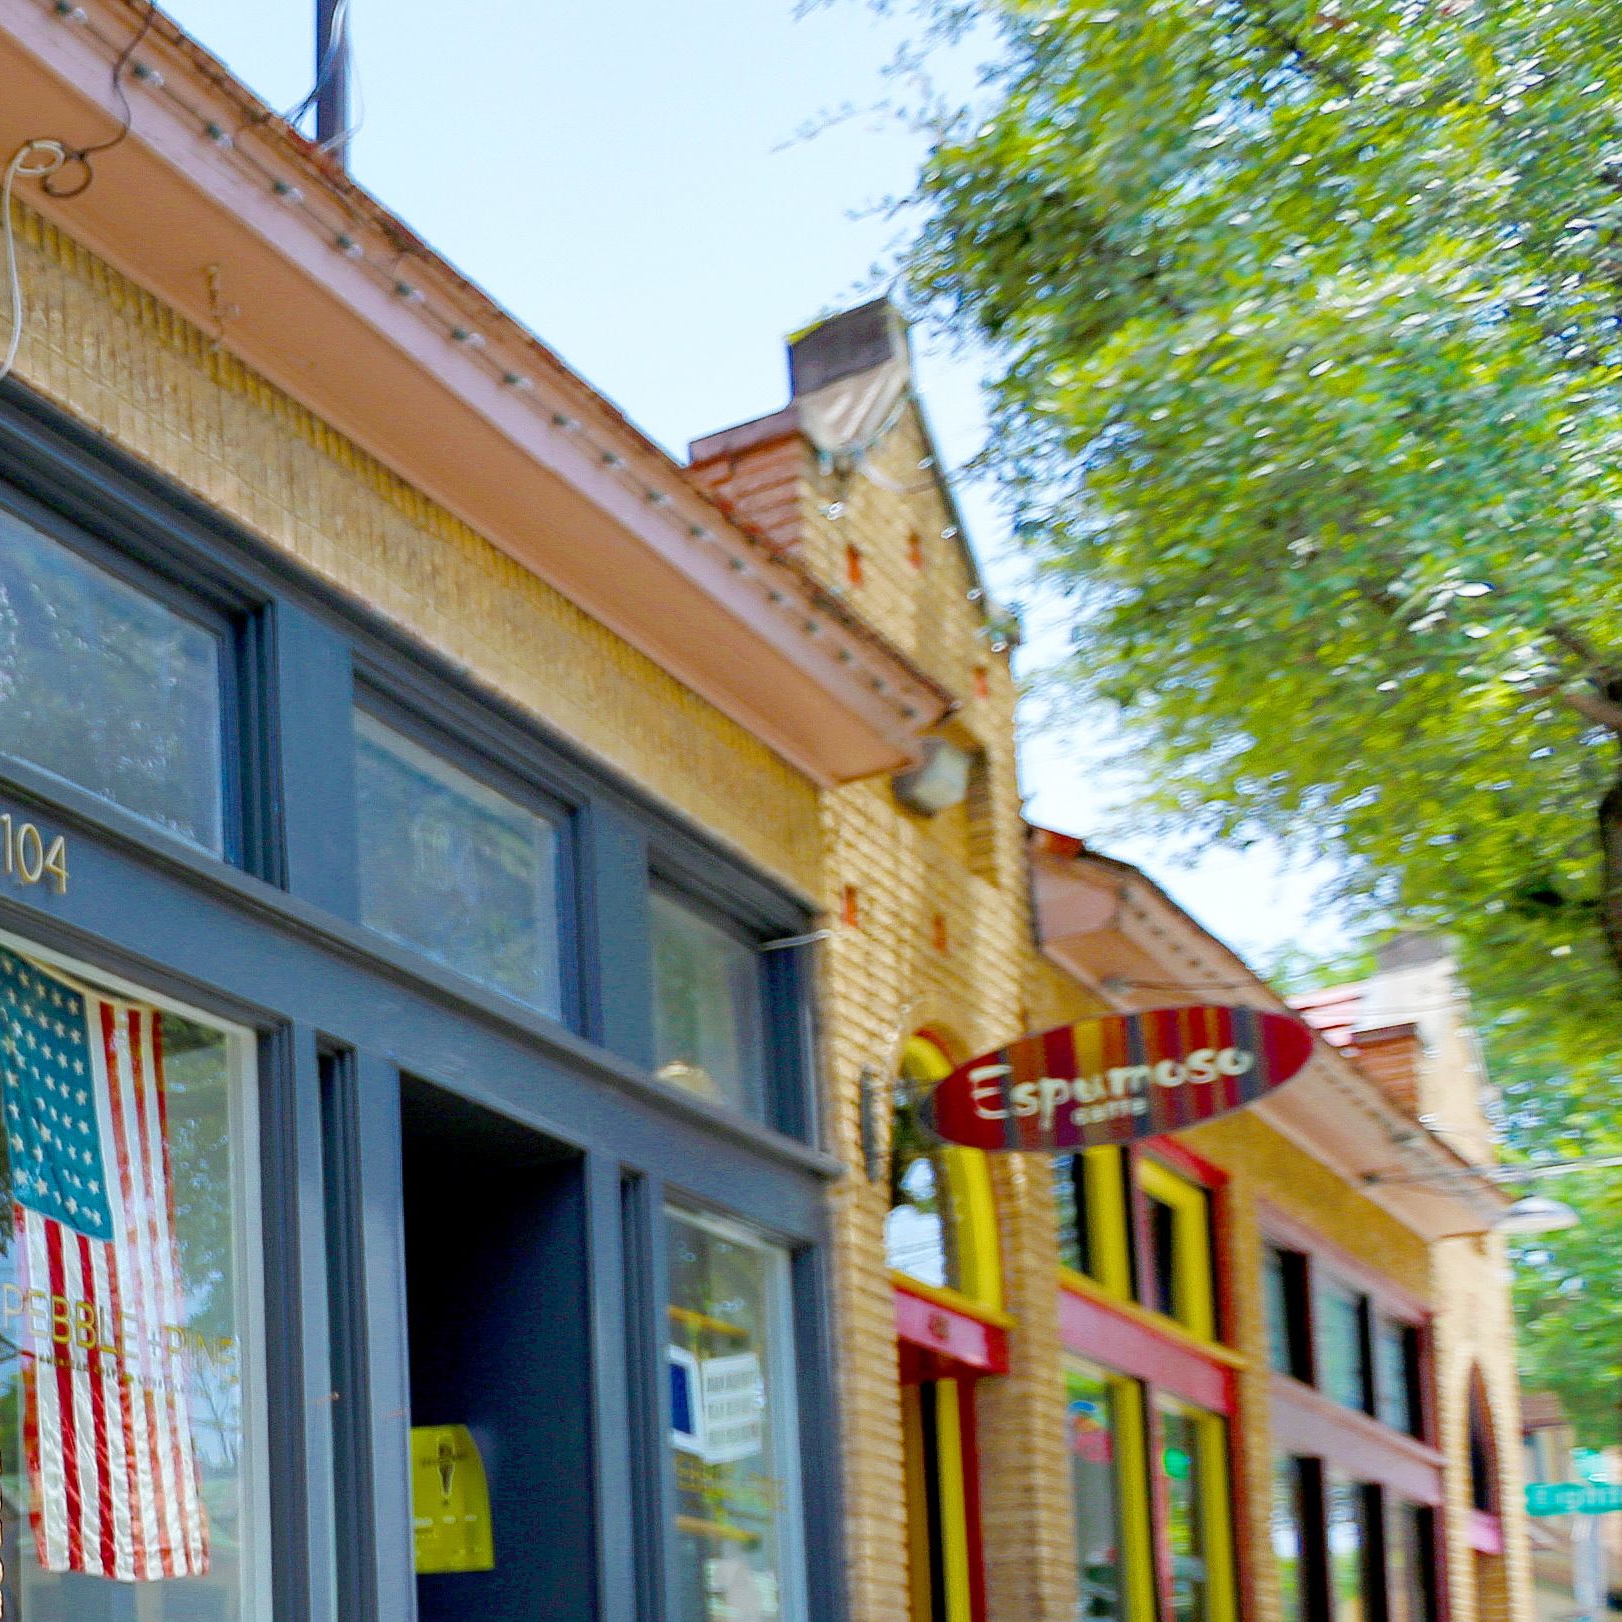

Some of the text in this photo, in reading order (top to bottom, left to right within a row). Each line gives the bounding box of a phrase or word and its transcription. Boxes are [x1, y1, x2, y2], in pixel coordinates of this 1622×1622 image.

[0, 812, 70, 894] 104
[968, 1048, 1254, 1131] Espumoso
[1, 1282, 139, 1361] PEBBLE
